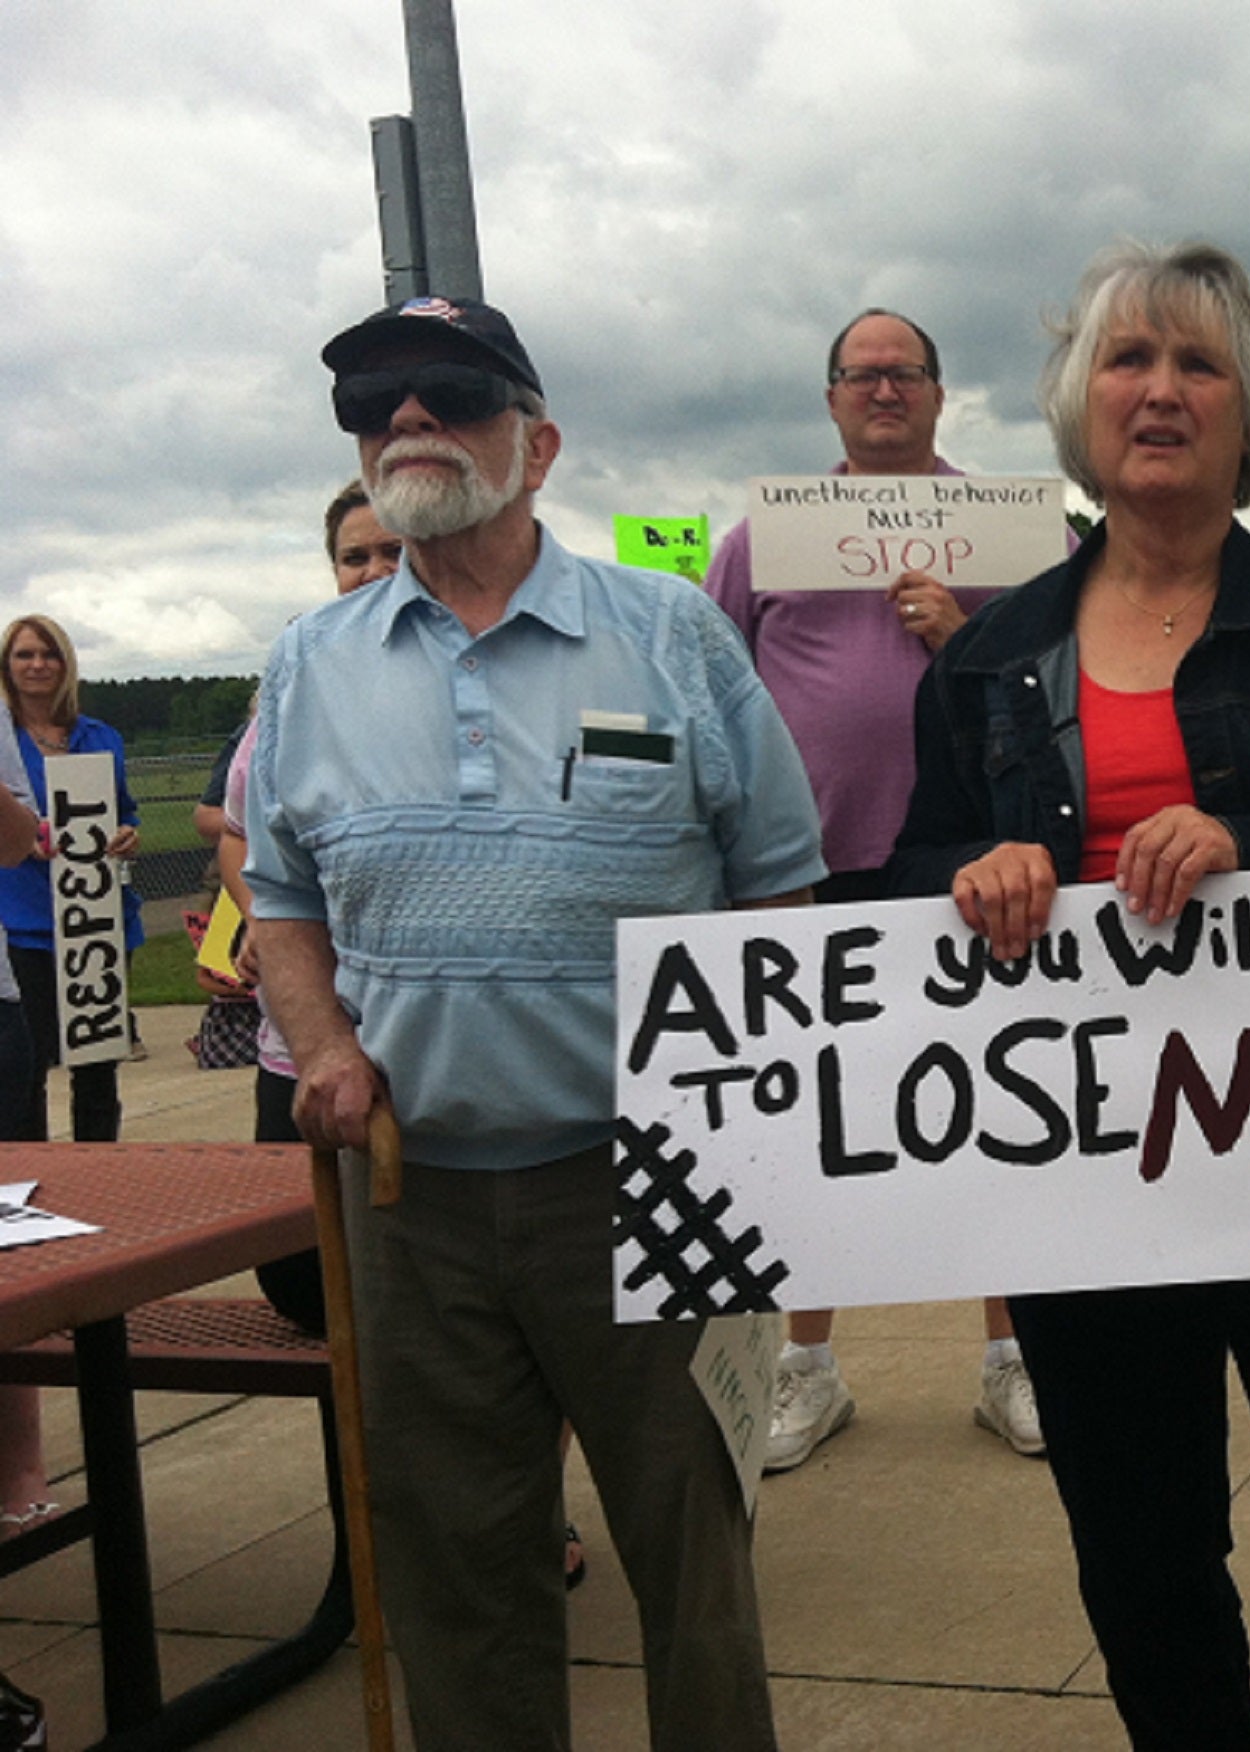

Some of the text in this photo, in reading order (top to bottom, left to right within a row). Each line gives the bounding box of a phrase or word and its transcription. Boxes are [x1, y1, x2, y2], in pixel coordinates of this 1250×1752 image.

[761, 481, 1048, 504] unethical behavior
[837, 535, 974, 578] STOP
[54, 790, 123, 1050] RESPECT
[628, 926, 884, 1074] ARE
[816, 1017, 1140, 1178] LOSE
